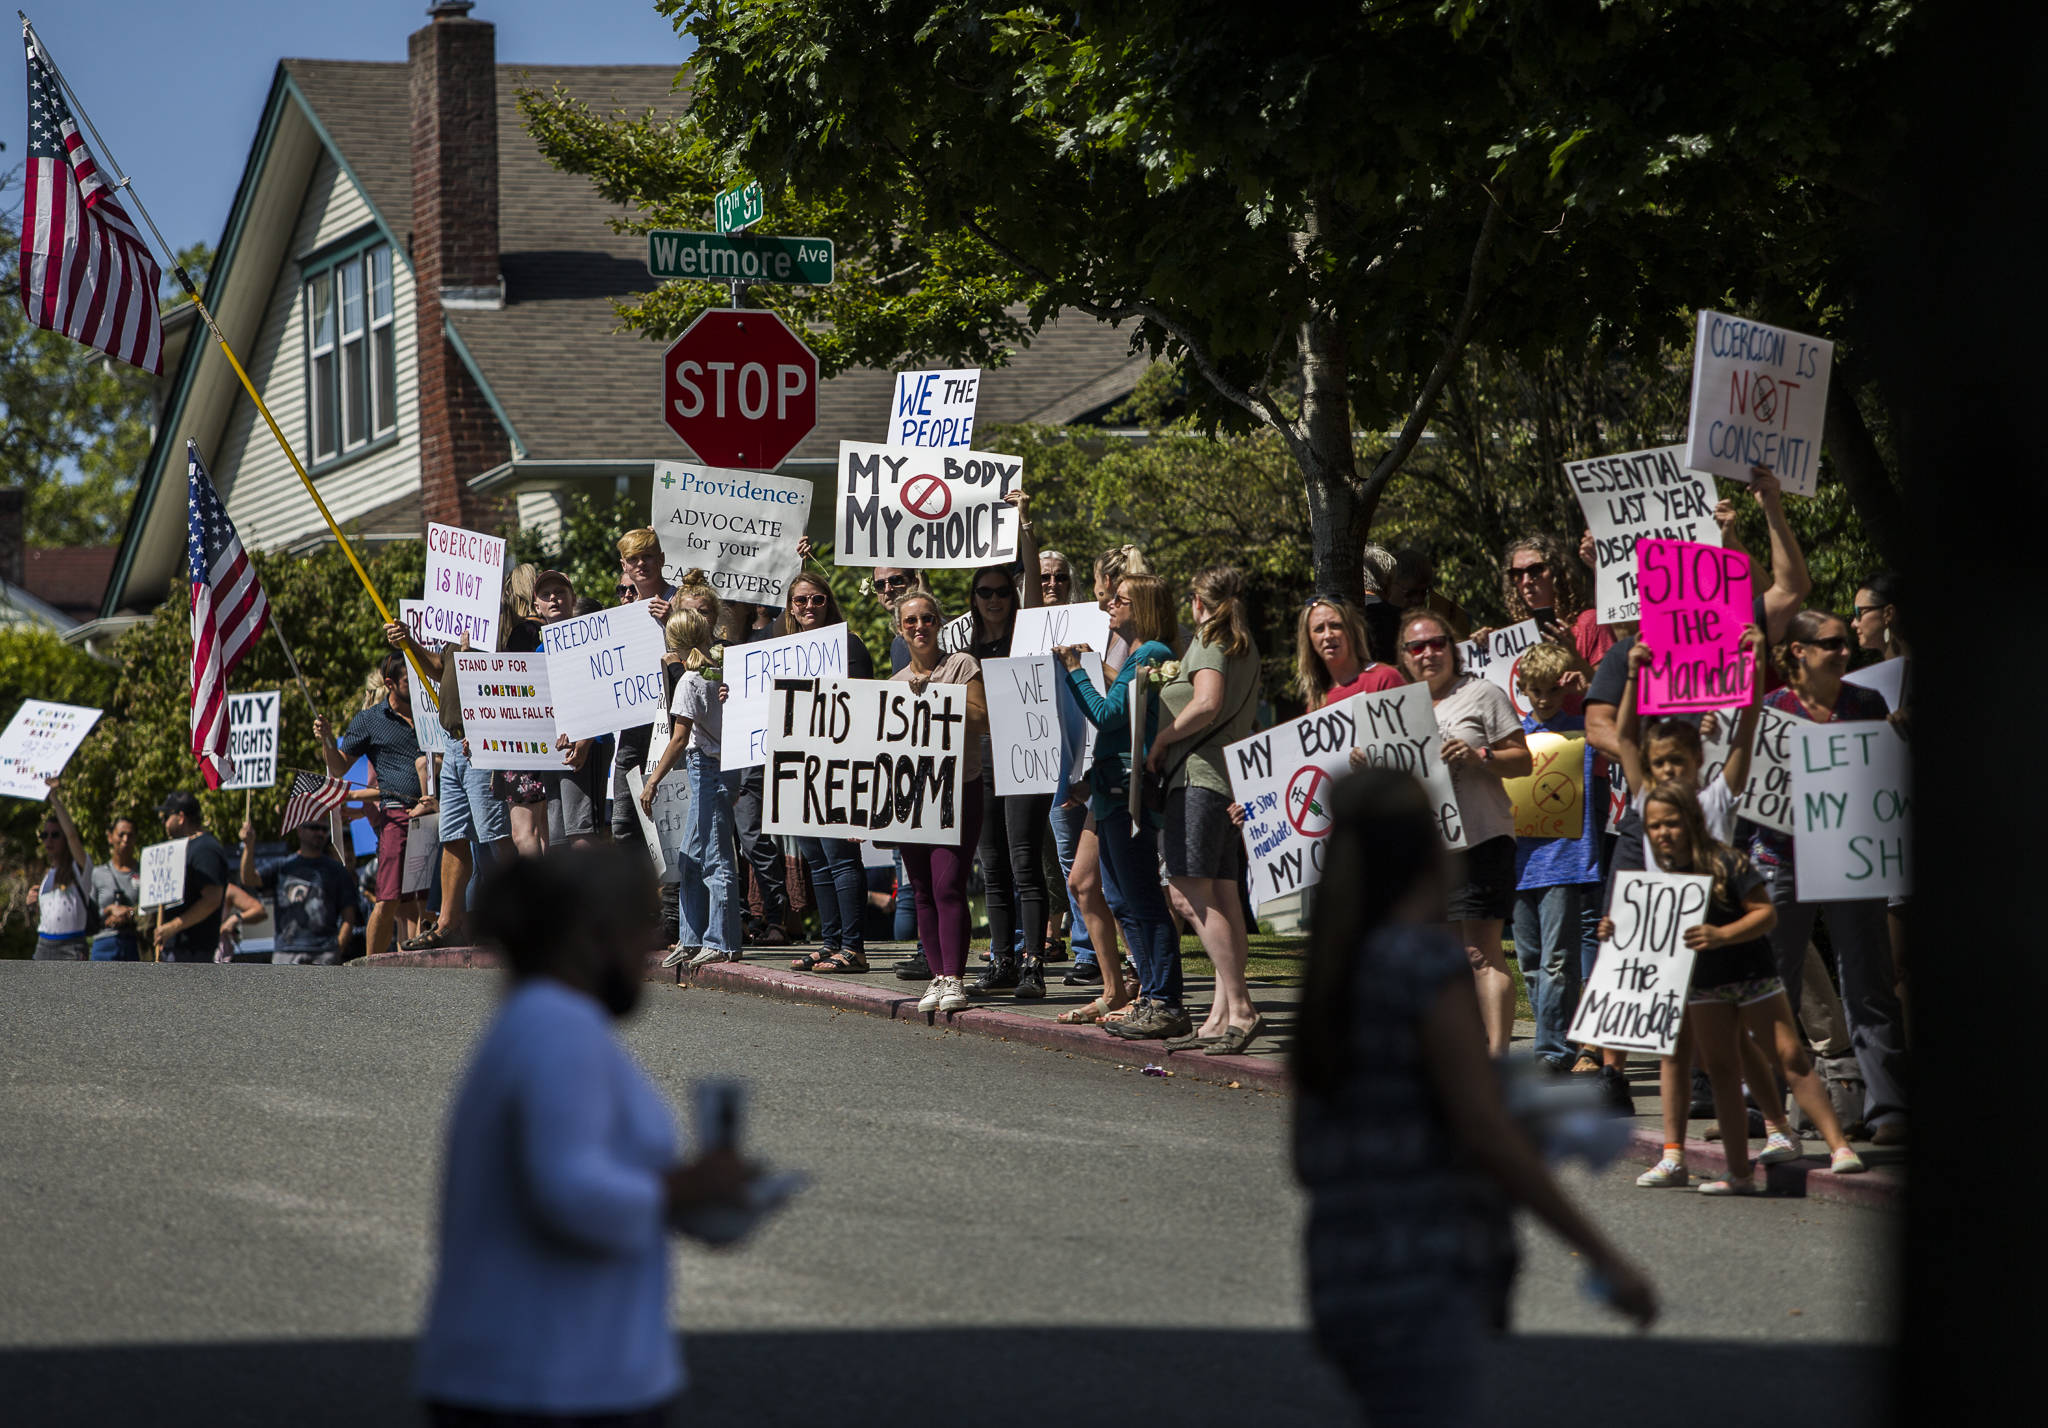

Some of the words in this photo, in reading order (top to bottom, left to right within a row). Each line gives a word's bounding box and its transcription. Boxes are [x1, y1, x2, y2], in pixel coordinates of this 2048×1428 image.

[654, 236, 791, 278] Wetmore
[797, 245, 828, 263] Ave
[1711, 318, 1786, 367] COERCION
[1795, 343, 1818, 379] IS
[674, 360, 807, 420] STOP
[899, 374, 940, 418] WE
[943, 378, 977, 405] THE
[1730, 369, 1801, 431] NOT
[902, 417, 973, 447] PEOPLE
[1570, 451, 1693, 494] ESSENTIAL
[1709, 420, 1811, 490] CONSENT!
[680, 473, 805, 505] Providence:
[847, 452, 909, 495] MY
[943, 457, 1021, 500] BODY
[670, 508, 782, 538] ADVOCATE
[845, 495, 903, 557] MY
[907, 501, 1018, 559] CHOICE
[1608, 491, 1646, 525] LAST
[429, 527, 501, 567] COERCION
[687, 532, 711, 550] for
[718, 541, 760, 558] your
[436, 567, 451, 592] IS
[456, 571, 482, 600] NOT
[661, 564, 782, 596] CAEGIVERS
[1644, 543, 1749, 605] STOP
[425, 606, 489, 643] CONSENT
[545, 614, 610, 655] FREEDOM
[1041, 609, 1069, 650] NO
[1495, 627, 1536, 657] CALL
[459, 659, 487, 671] STAND
[492, 660, 504, 672] UP
[508, 660, 527, 673] FOR
[590, 645, 625, 680] NOT
[478, 684, 536, 697] SOMETHING
[1012, 664, 1048, 704] WE
[231, 696, 275, 725] MY
[463, 708, 475, 720] OR
[479, 707, 496, 720] YOU
[500, 706, 521, 720] WILL
[522, 707, 543, 719] FALL
[774, 678, 850, 744] This
[1026, 712, 1048, 741] DO
[1366, 695, 1409, 739] MY
[231, 727, 272, 755] RIGHTS
[483, 739, 548, 754] ANYTHING
[1237, 735, 1273, 780] MY
[1297, 710, 1356, 757] BODY
[1803, 732, 1879, 773] LET
[772, 750, 957, 830] FREEDOM
[1250, 821, 1268, 840] the
[1804, 791, 1847, 832] MY
[1254, 820, 1293, 859] mandate
[1268, 848, 1302, 893] MY
[1612, 879, 1705, 957] STOP
[1613, 957, 1660, 993] the
[1574, 989, 1681, 1049] Mandate
